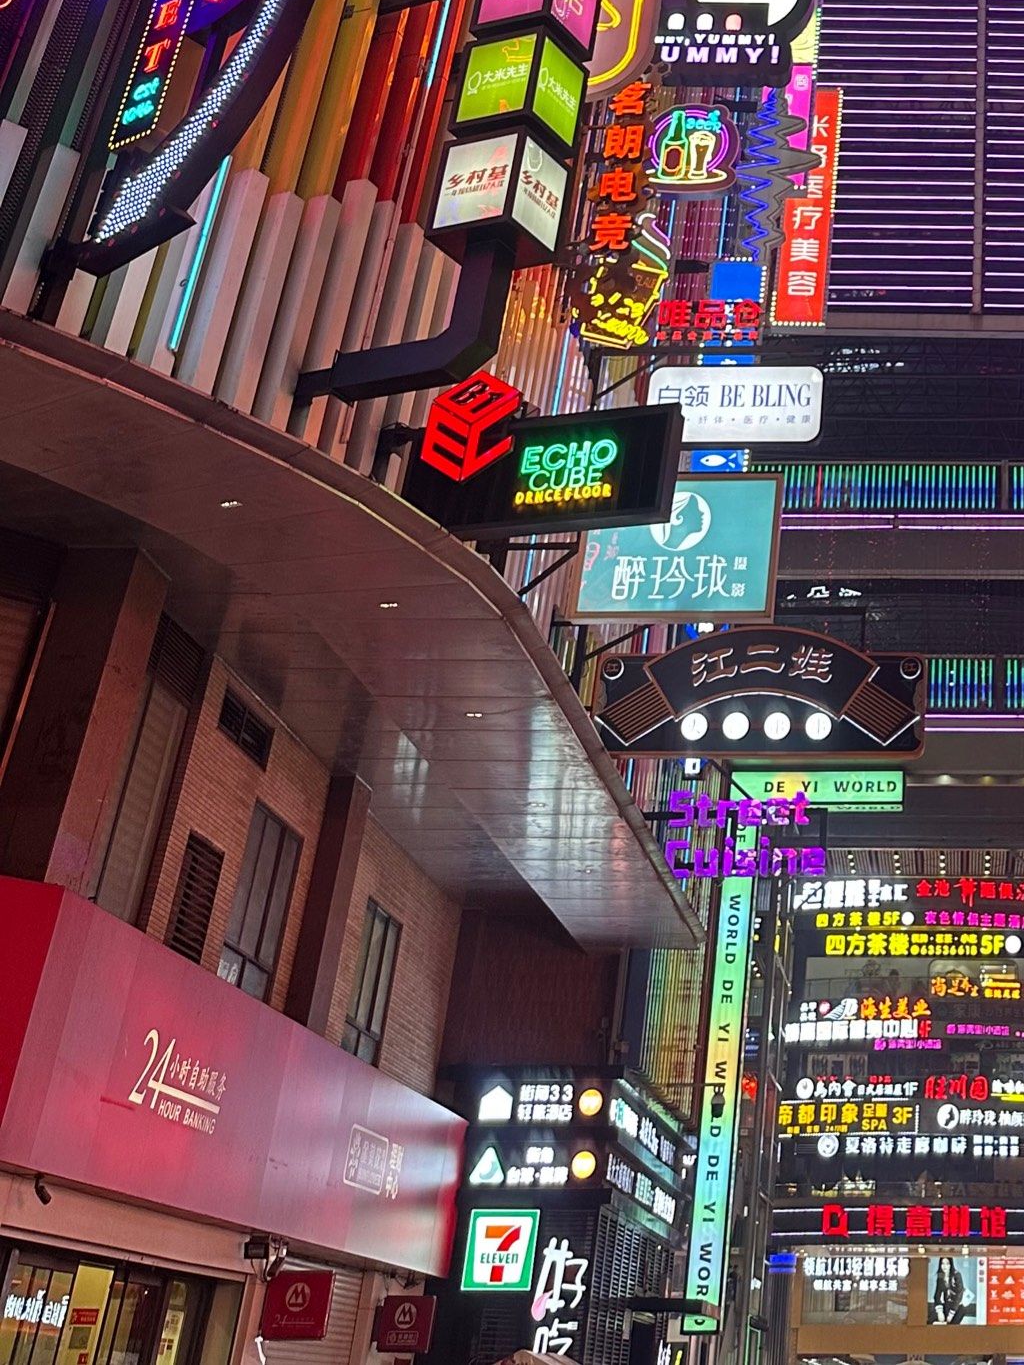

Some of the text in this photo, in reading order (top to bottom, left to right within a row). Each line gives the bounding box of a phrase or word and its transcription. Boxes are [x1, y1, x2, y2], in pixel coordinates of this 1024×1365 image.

[695, 34, 775, 45] YUMMY!
[483, 64, 529, 83] 大米先生
[548, 76, 577, 111] 大米先生
[446, 164, 509, 190] 乡村基
[520, 171, 560, 212] 乡村基
[658, 299, 764, 328] 唯品仓
[658, 384, 812, 409] 白领 BE BLING
[521, 439, 618, 475] ECHO
[529, 465, 603, 492] CUBE
[763, 780, 898, 793] DE YI WORLD
[668, 791, 811, 828] Street
[665, 836, 827, 878] Cuisine
[882, 911, 900, 926] 5F
[826, 933, 909, 956] 四方茶楼
[980, 934, 1005, 955] 5F
[128, 1028, 176, 1108] 24
[702, 894, 741, 1223] WORLD DE YI DE YI
[170, 1053, 228, 1102] 小时自助服务
[158, 1100, 216, 1135] HOUR BANKING
[778, 1102, 859, 1126] 帝都印象
[892, 1106, 913, 1125] 3F
[861, 1119, 888, 1131] SPA
[480, 1251, 518, 1265] ELEVEN
[484, 1225, 521, 1283] 7
